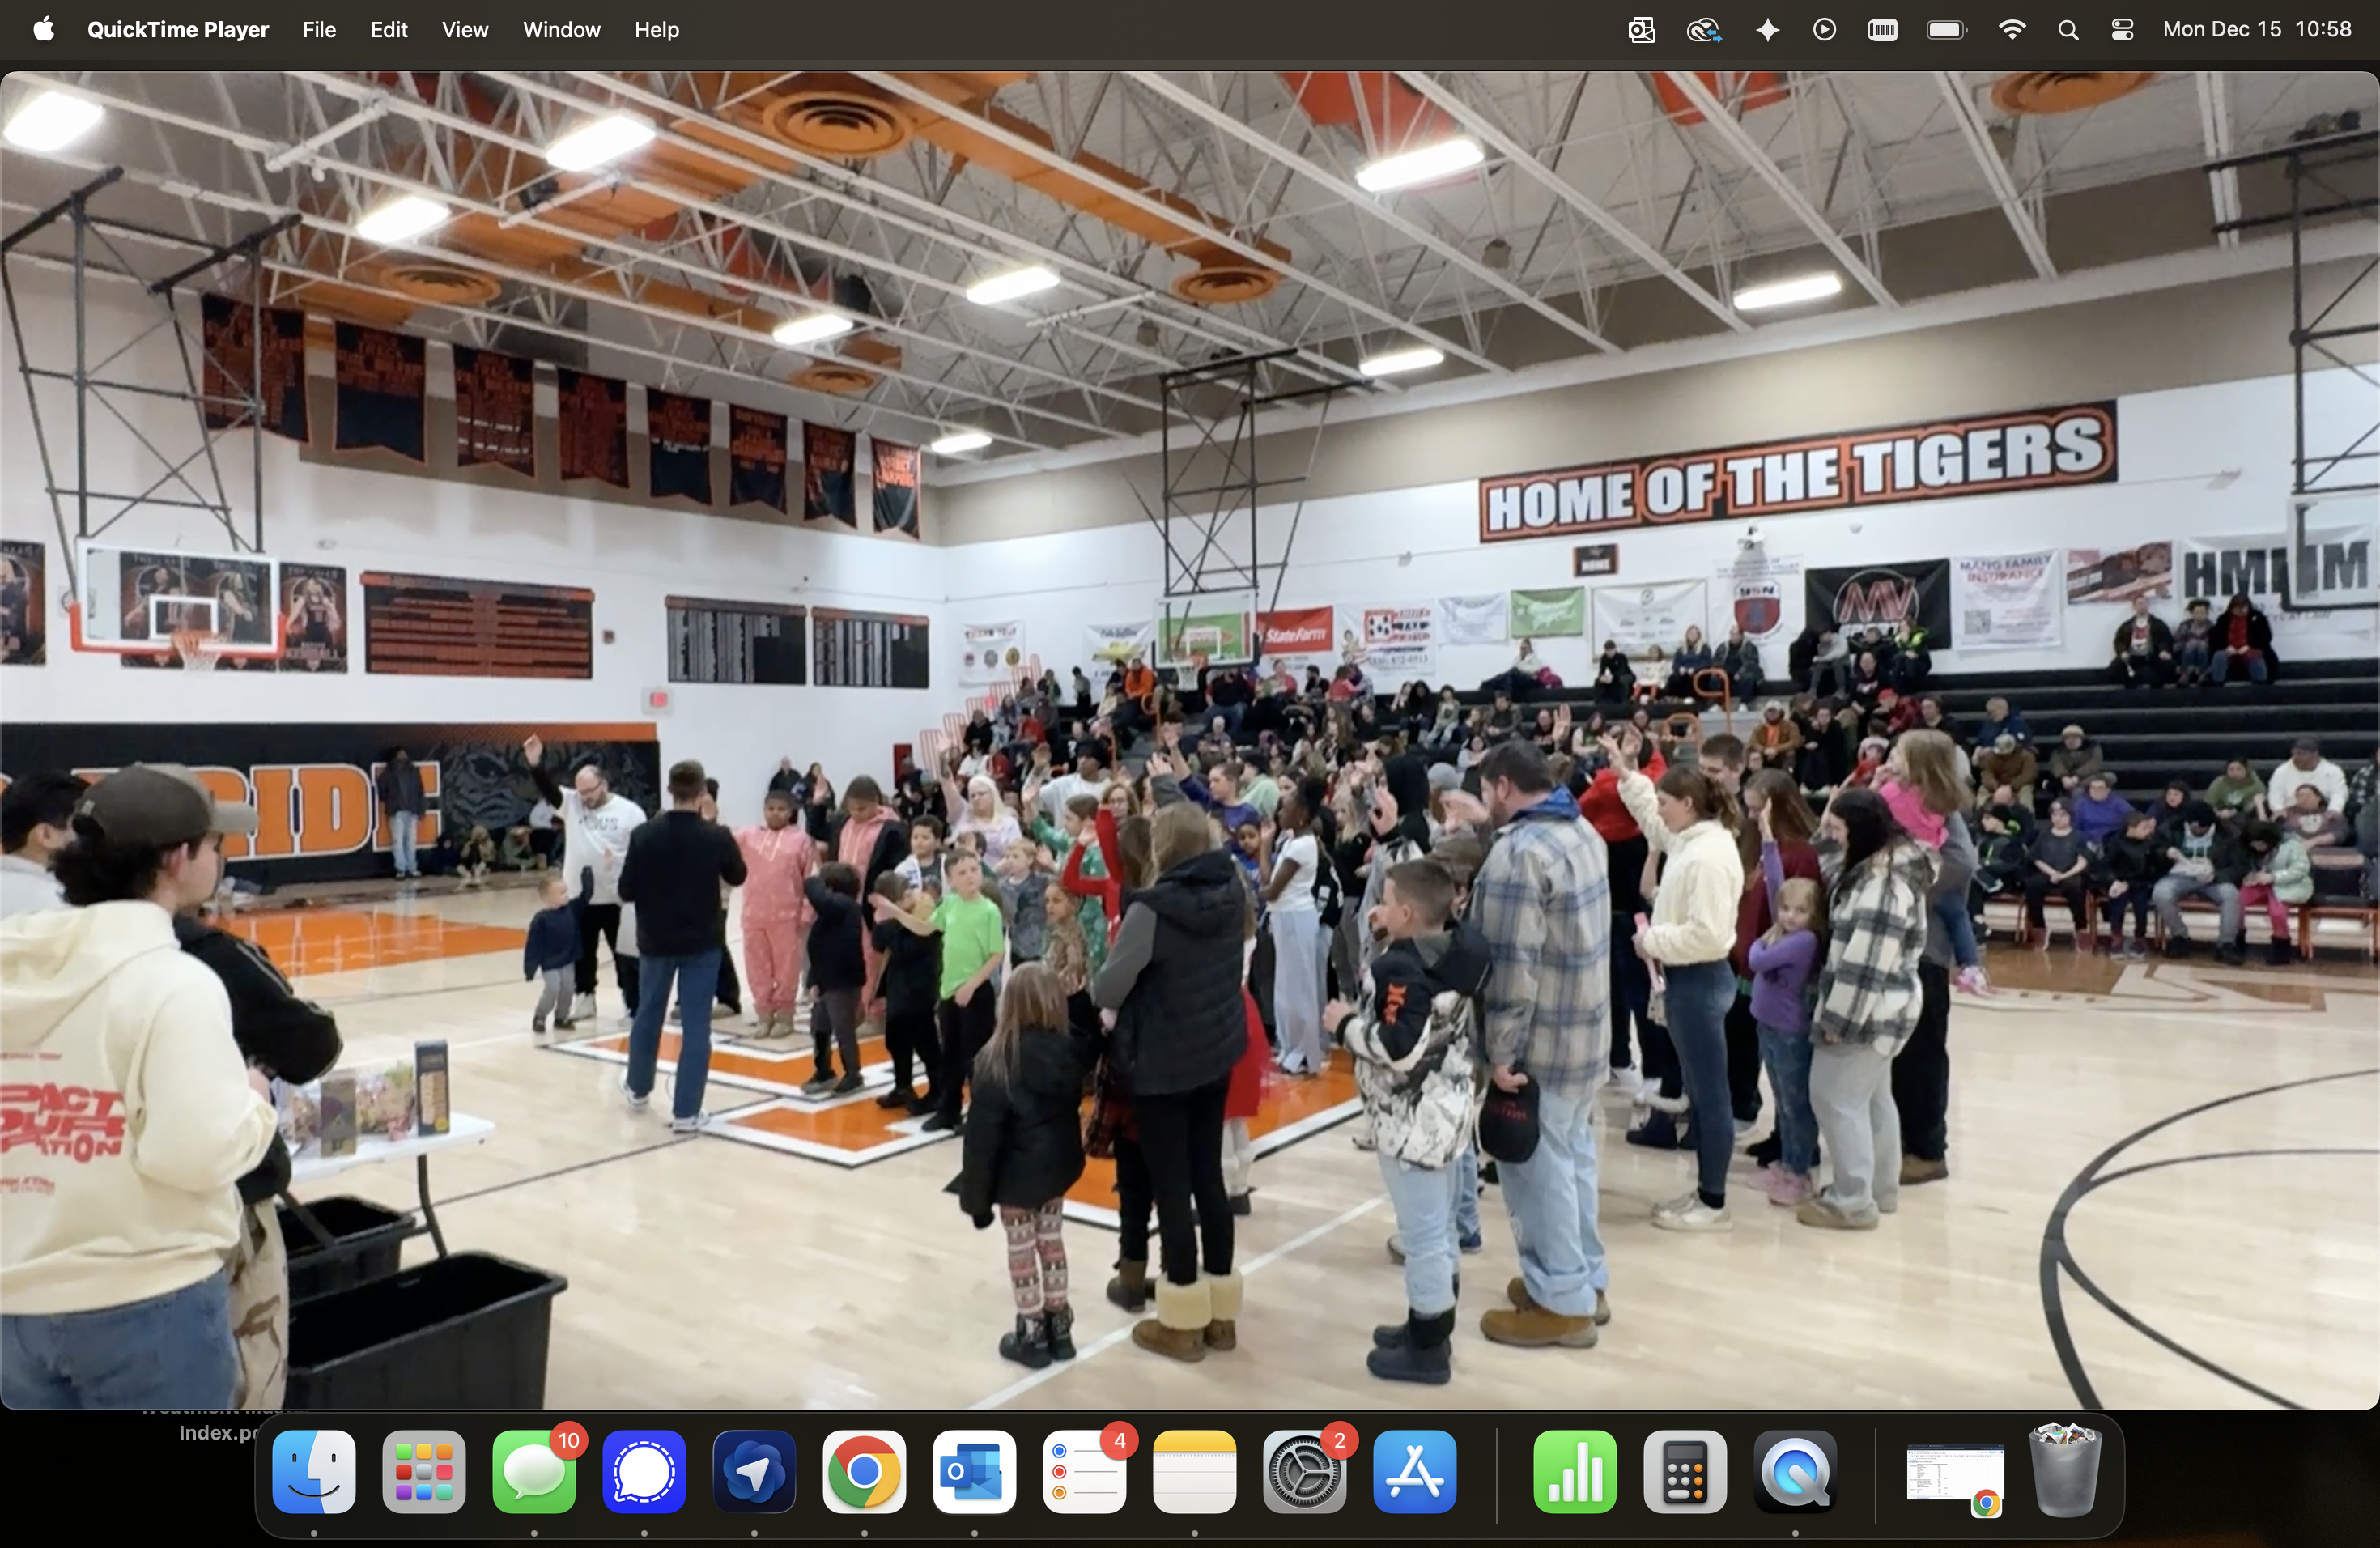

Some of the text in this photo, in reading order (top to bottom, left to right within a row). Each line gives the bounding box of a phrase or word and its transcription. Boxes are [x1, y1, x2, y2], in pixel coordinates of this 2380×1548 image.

[87, 20, 270, 42] QuickTime Player
[304, 20, 337, 38] File
[372, 20, 409, 38] Edit
[441, 20, 490, 38] View
[523, 20, 601, 38] Window
[635, 20, 680, 42] Help
[2164, 20, 2282, 37] Mon Dec 15
[2296, 20, 2352, 37] 10:58
[1488, 415, 2104, 532] HOME OF THE TIGERS
[559, 1432, 580, 1449] 10
[1114, 1432, 1126, 1448] 4
[1334, 1432, 1345, 1448] 2
